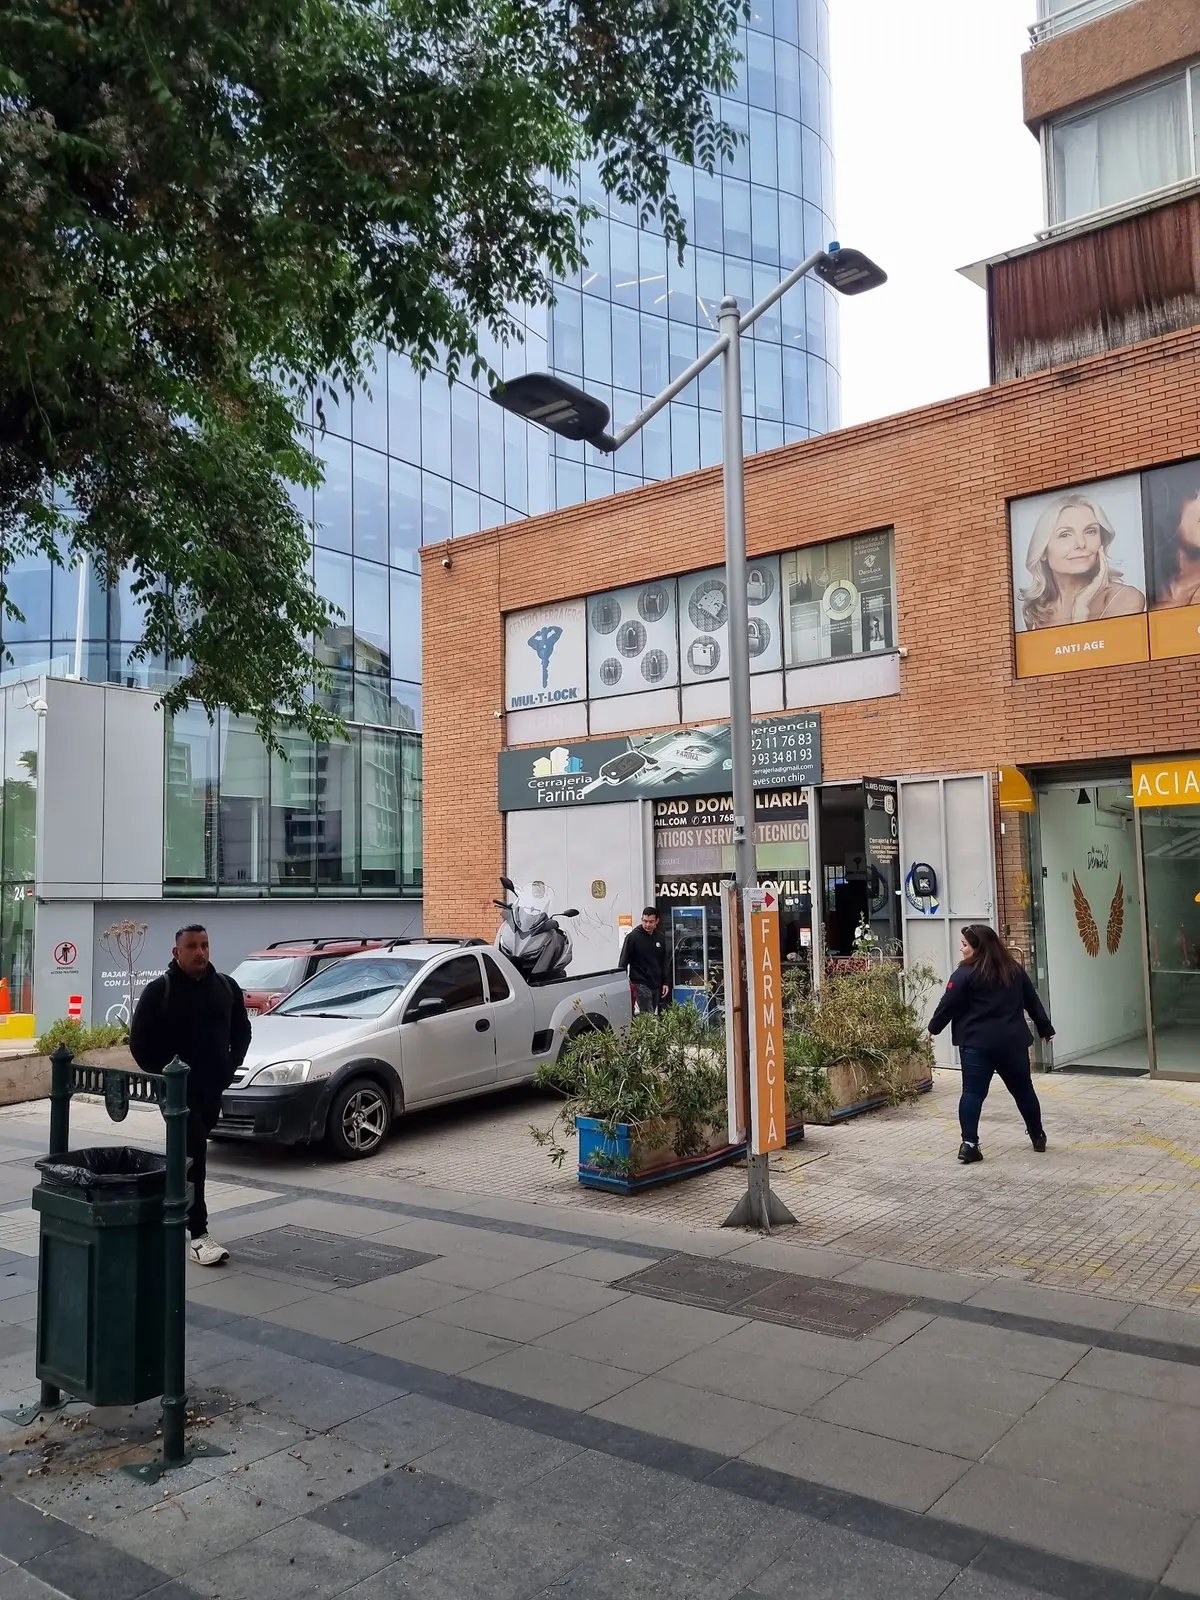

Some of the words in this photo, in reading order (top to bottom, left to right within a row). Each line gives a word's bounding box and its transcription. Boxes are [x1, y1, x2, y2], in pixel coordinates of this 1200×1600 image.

[1054, 643, 1080, 655] ANTI
[1083, 640, 1105, 651] AGE
[751, 720, 817, 736] ergencia
[766, 736, 777, 749] 11
[781, 734, 796, 748] 76
[798, 732, 812, 746] 83
[758, 752, 770, 766] 93
[772, 751, 784, 764] 34
[786, 749, 797, 763] 81
[800, 748, 812, 761] 93
[752, 778, 770, 786] aves
[771, 775, 786, 784] con
[787, 773, 806, 782] chip
[1137, 770, 1200, 797] ACIA
[537, 787, 585, 803] Fariña
[657, 800, 689, 816] DAD
[655, 817, 688, 827] AIL.COM
[701, 814, 716, 824] 211
[719, 814, 734, 824] 768
[656, 830, 694, 848] ATICOS
[694, 829, 703, 847] Y
[14, 887, 25, 900] 24
[761, 918, 778, 1144] FARMACIA
